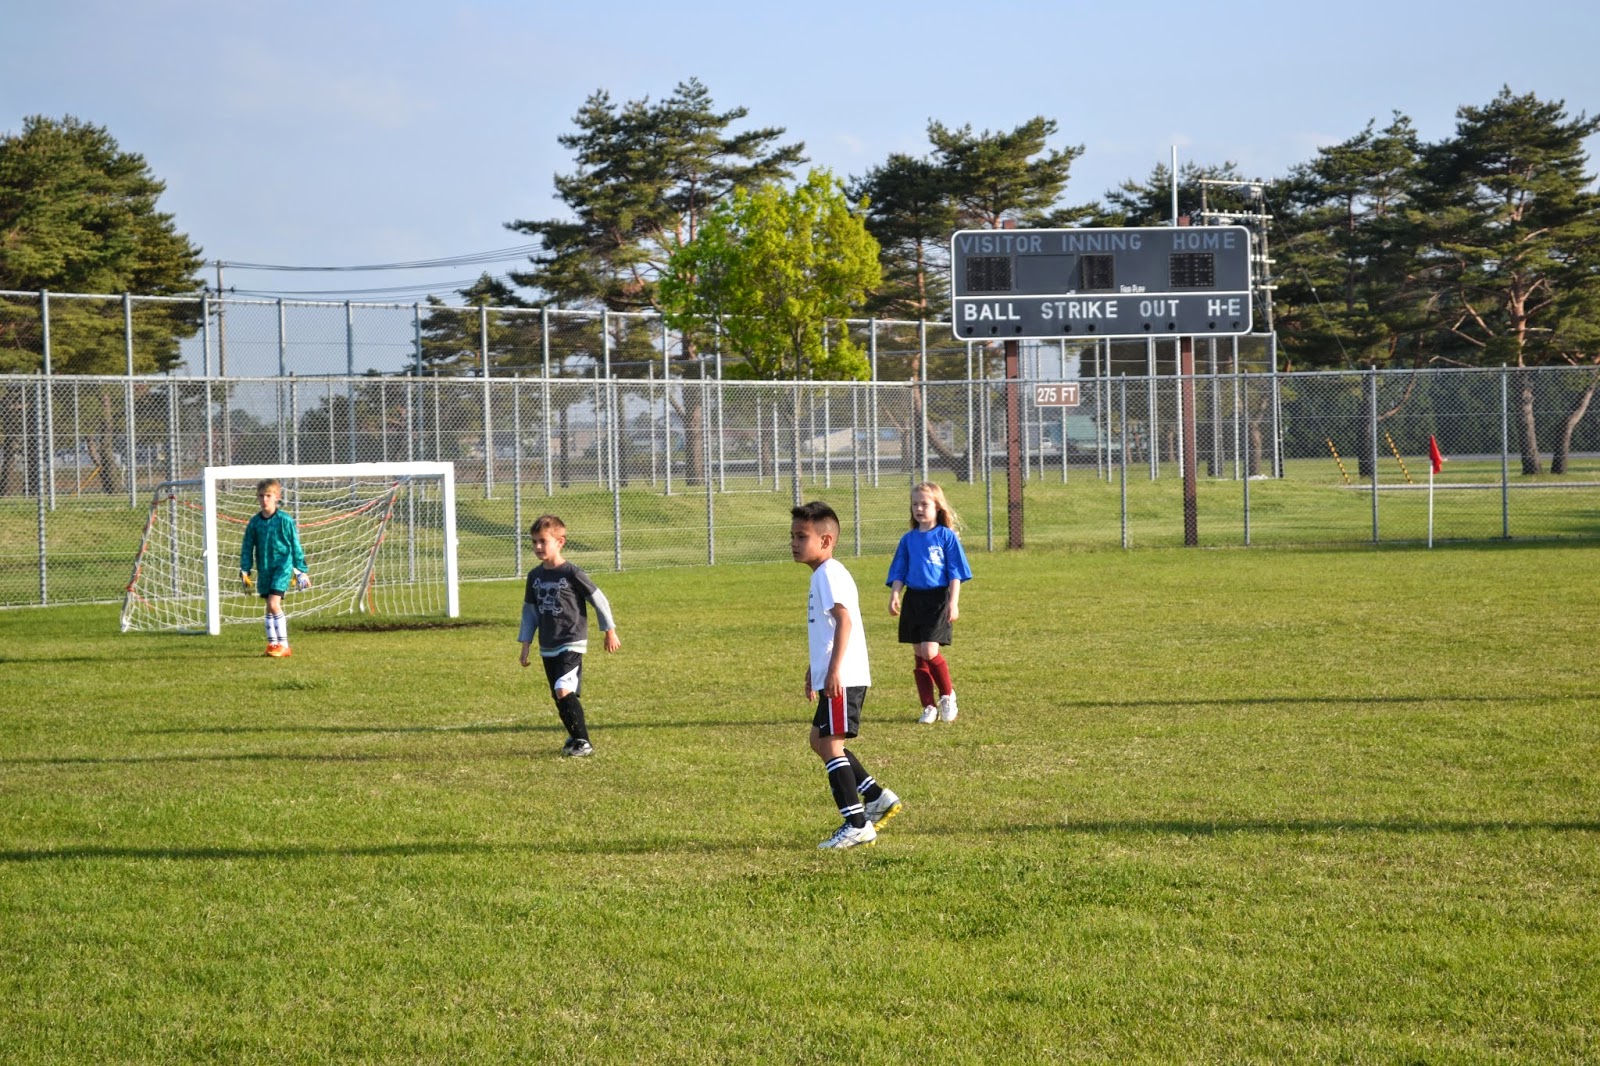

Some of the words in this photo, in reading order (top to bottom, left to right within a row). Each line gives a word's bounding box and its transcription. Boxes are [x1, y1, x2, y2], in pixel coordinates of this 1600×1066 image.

[959, 235, 1042, 253] VISITOR
[1062, 233, 1142, 252] INNING
[1173, 232, 1235, 250] HOME
[963, 303, 1021, 320] BALL
[1041, 301, 1118, 319] STRIKE
[1140, 299, 1179, 317] OUT
[1207, 298, 1241, 317] H-E
[1037, 387, 1057, 402] 275
[1061, 387, 1076, 402] FT
